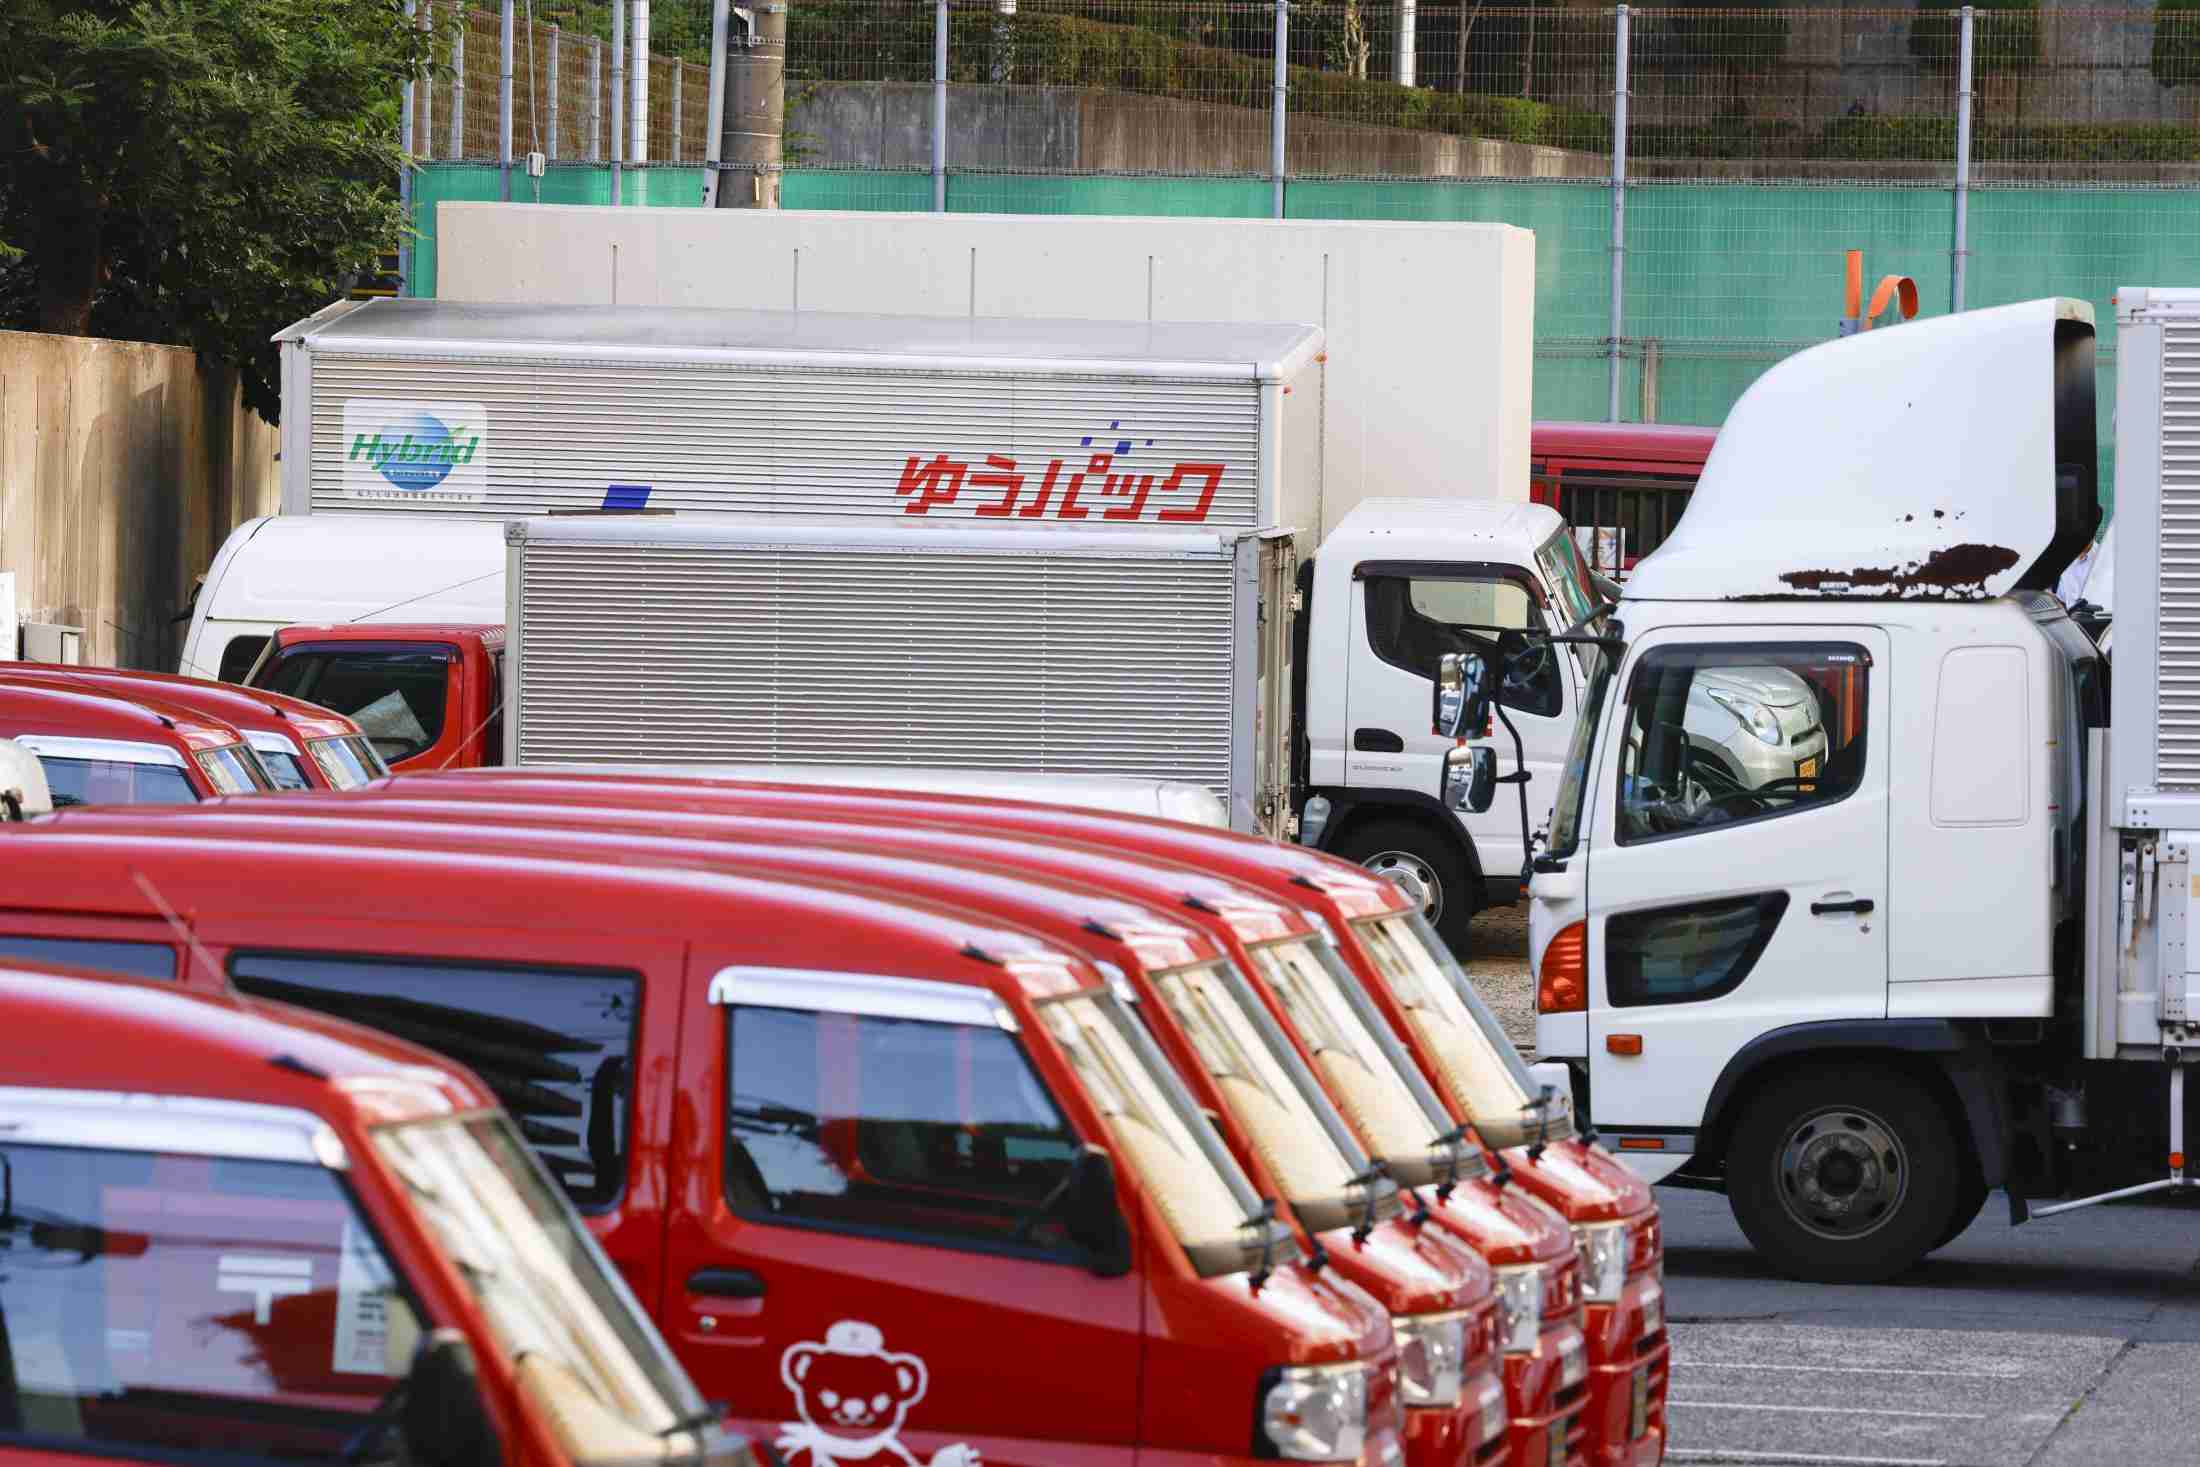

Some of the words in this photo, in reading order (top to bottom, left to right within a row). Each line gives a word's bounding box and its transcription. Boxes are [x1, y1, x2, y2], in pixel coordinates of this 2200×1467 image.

[349, 429, 480, 470] Hybrid
[895, 452, 1226, 522] ゆうパック
